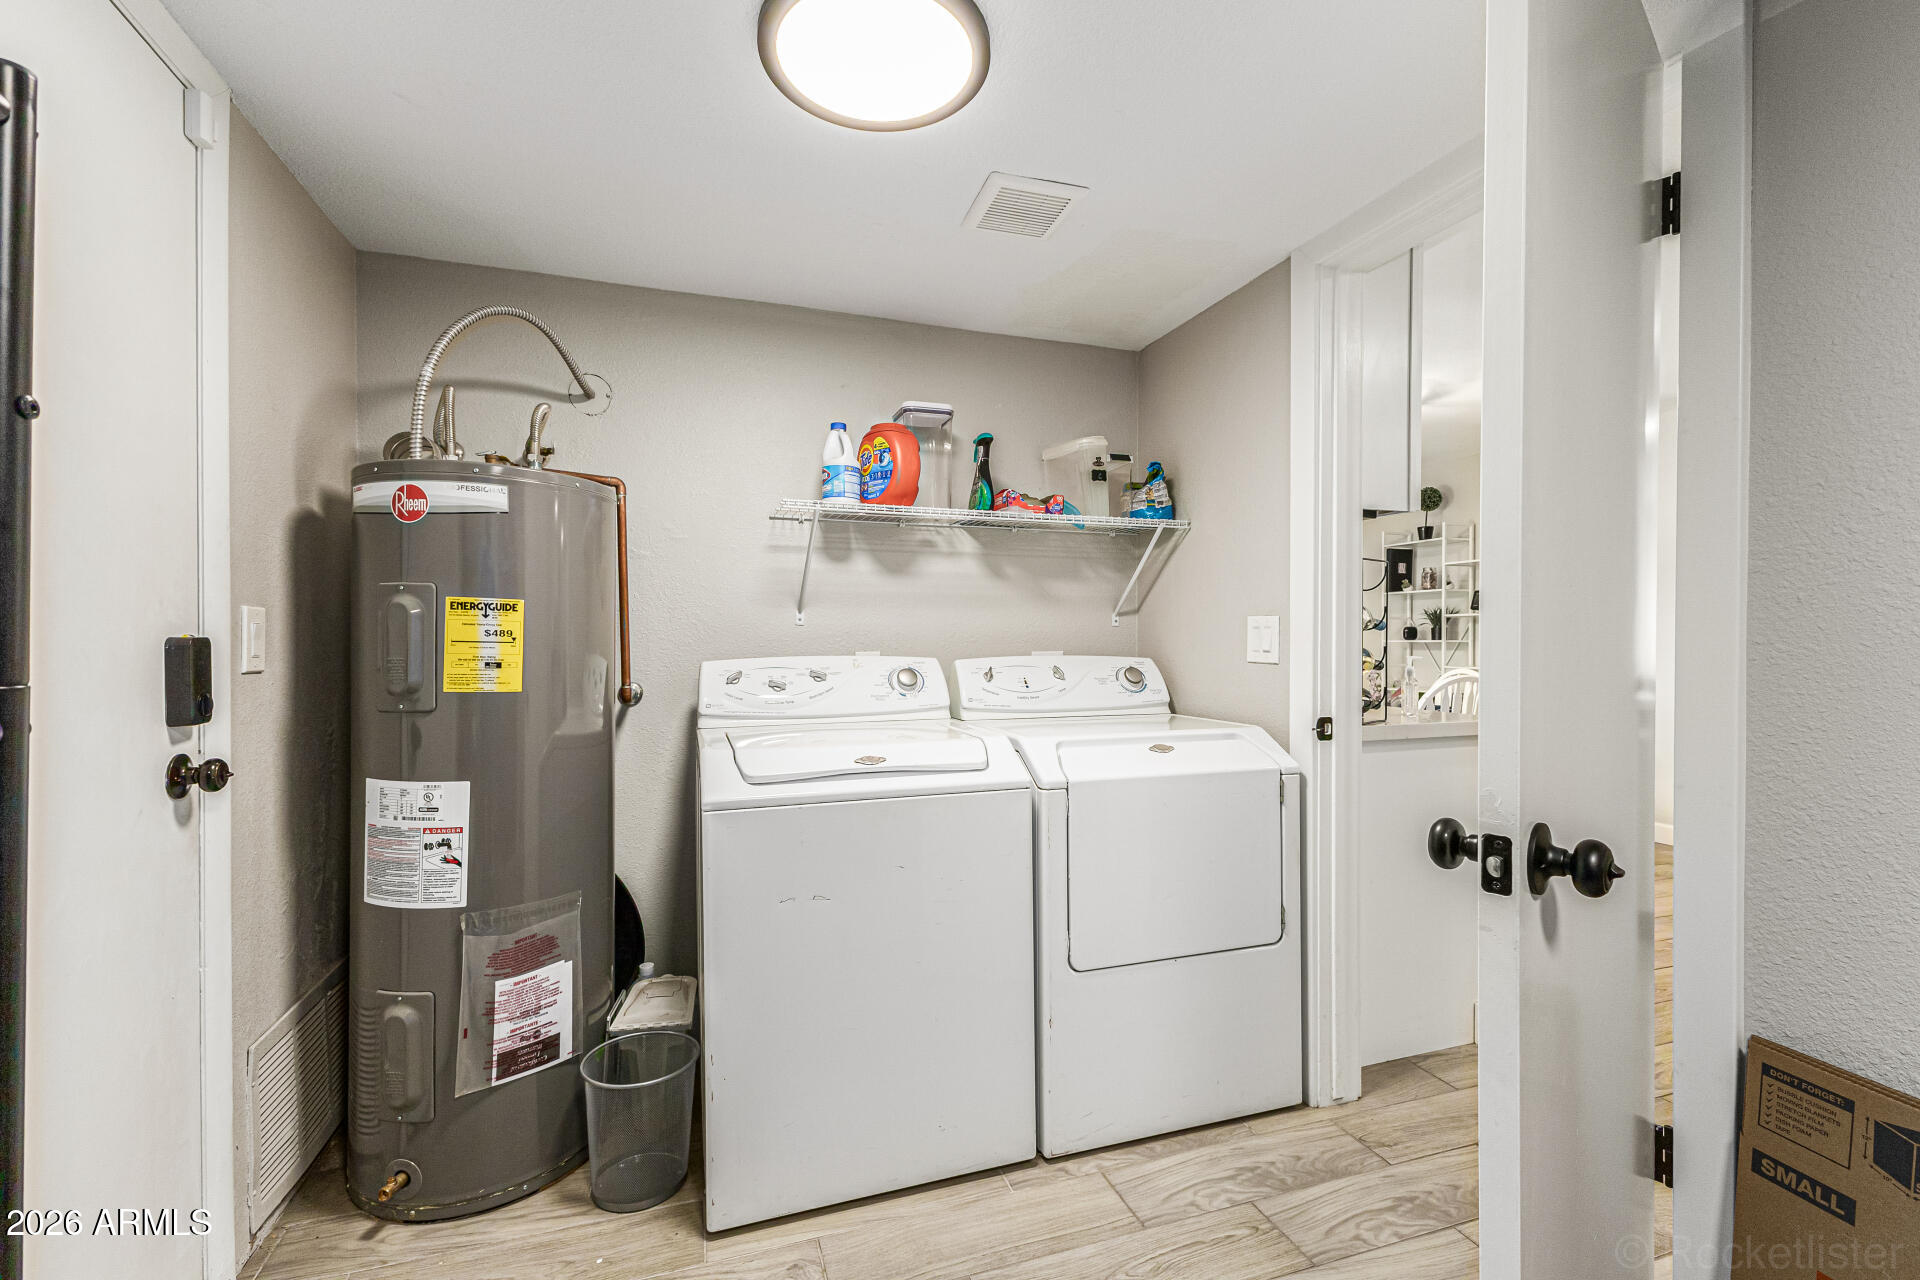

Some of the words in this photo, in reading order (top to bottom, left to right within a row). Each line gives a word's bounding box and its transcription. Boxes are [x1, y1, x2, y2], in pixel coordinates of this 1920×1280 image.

[860, 450, 873, 469] Tide
[395, 484, 426, 517] Rheem
[484, 629, 513, 638] $489
[513, 974, 538, 986] IMPORTANT
[1769, 1068, 1799, 1087] DON'T
[1776, 1094, 1803, 1110] MOVING
[1804, 1107, 1841, 1127] BLANKETS
[1776, 1101, 1806, 1119] STRETCH
[1808, 1115, 1824, 1127] FILM
[1805, 1099, 1837, 1118] CUSHION
[1775, 1108, 1804, 1127] PACKING
[1805, 1123, 1829, 1138] PAPER
[1775, 1116, 1791, 1127] DISH
[1791, 1124, 1812, 1138] FOAM
[1775, 1124, 1791, 1136] TAPE
[1760, 1157, 1845, 1217] SMALL
